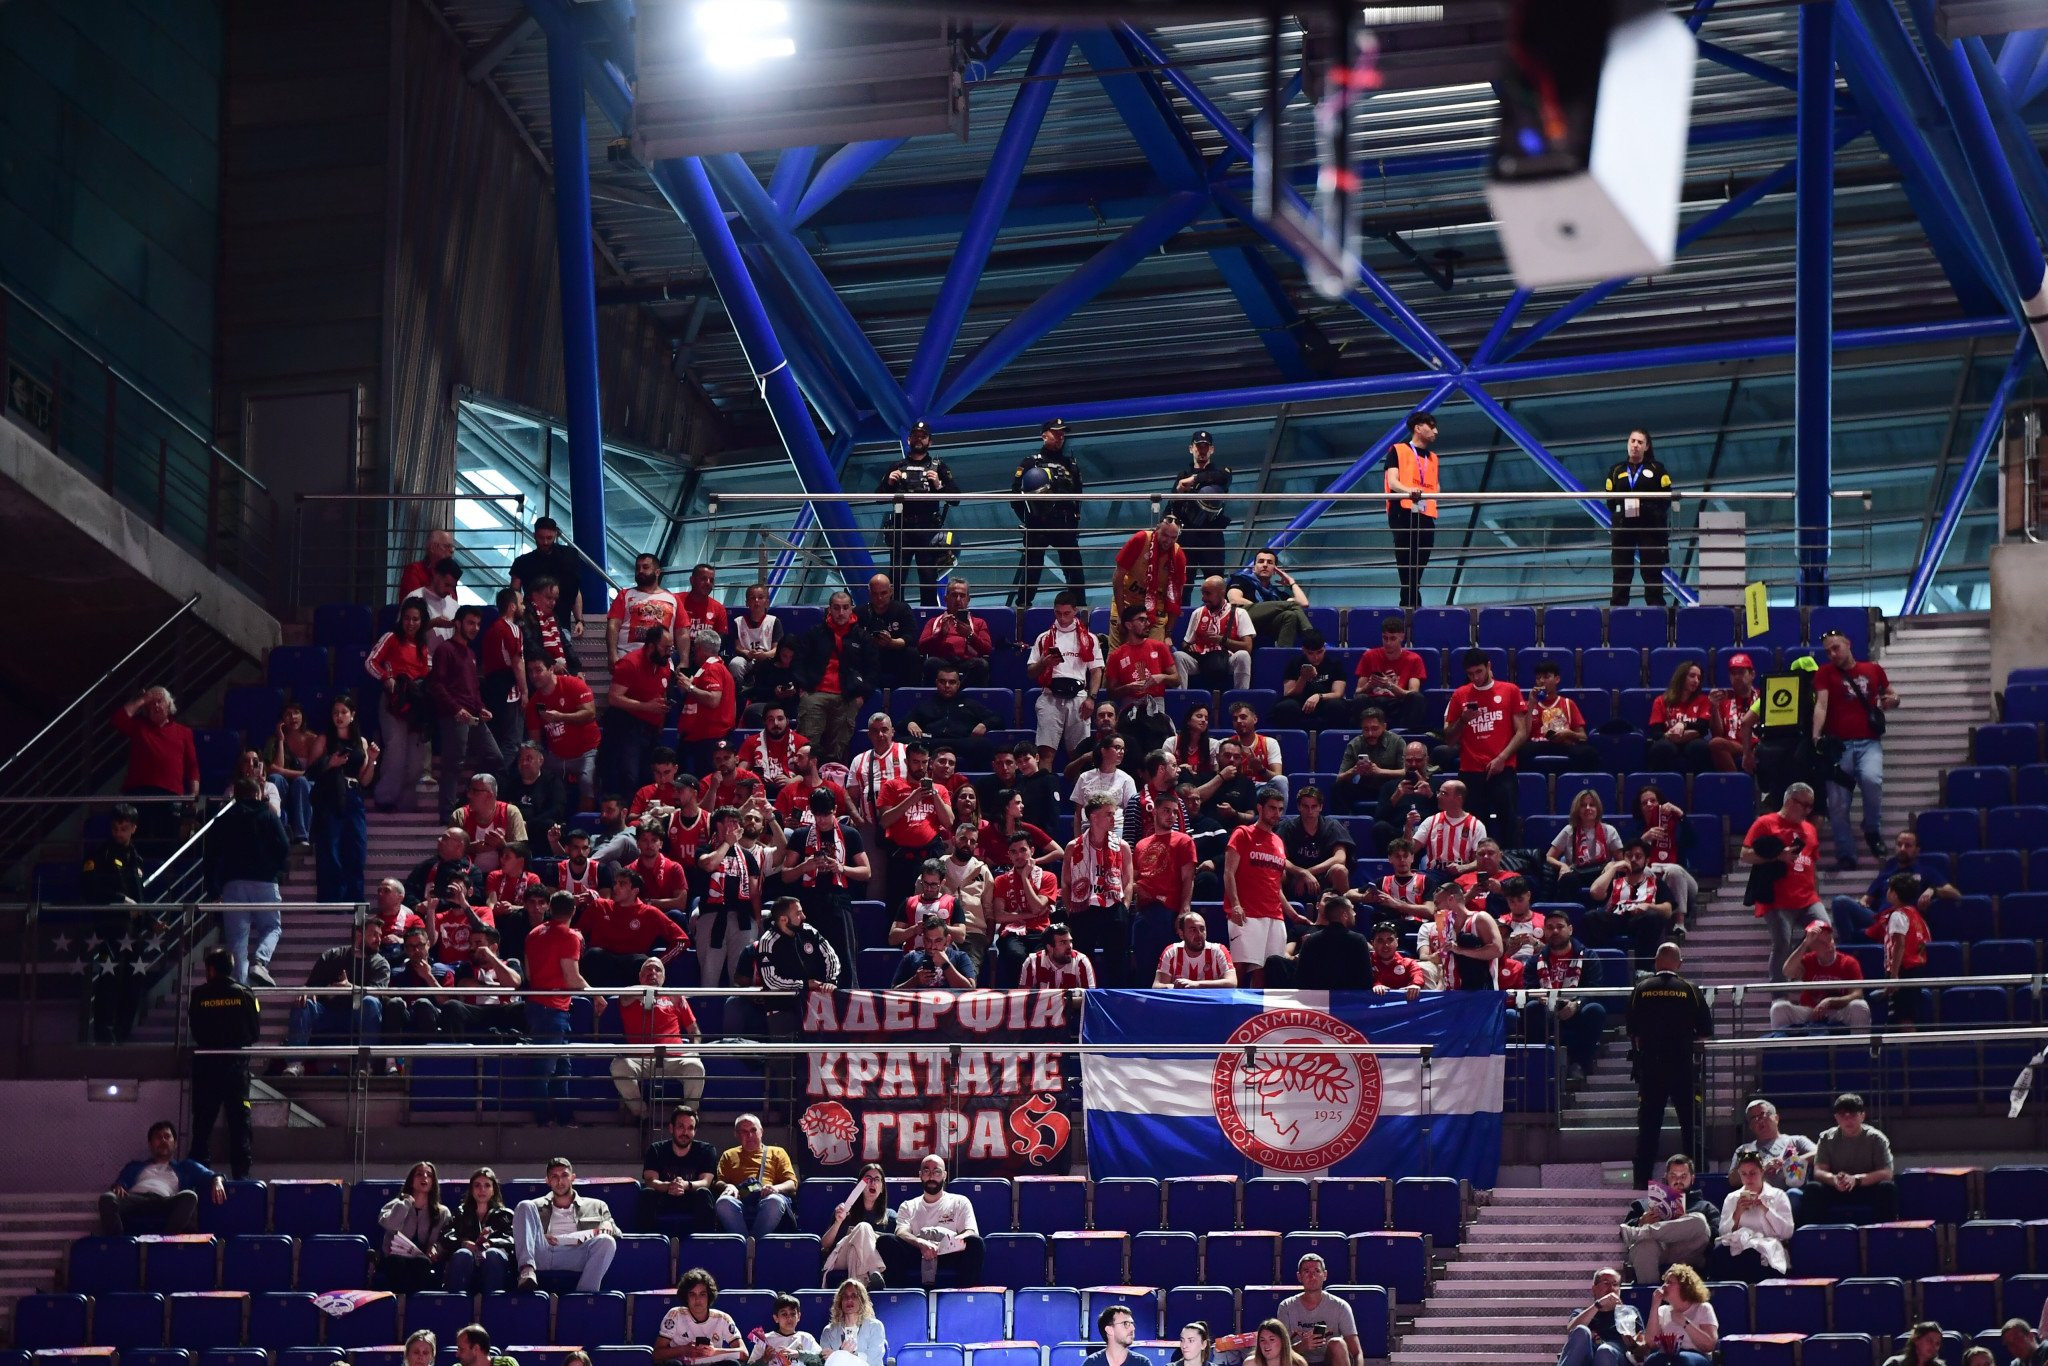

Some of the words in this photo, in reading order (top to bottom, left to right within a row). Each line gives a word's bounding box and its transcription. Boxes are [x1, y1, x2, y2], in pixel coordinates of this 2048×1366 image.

[1471, 721, 1494, 733] TIME
[681, 844, 695, 858] 14
[803, 989, 1067, 1032] ΑΔΕΡΦΙΑ
[1642, 990, 1688, 999] PROSEGUR
[1238, 1012, 1357, 1044] ΟΛΥΜΠΙΑΚΟΣ
[806, 1050, 1063, 1099] ΚΡΑΤΑΤΕ
[1259, 1136, 1357, 1168] ΦΙΛΑΘΛΩΝ
[1355, 1054, 1378, 1129] ΠΕΙΡΑΙΩ
[1314, 1110, 1343, 1122] 1925
[861, 1109, 1009, 1161] ΓΕΡΑ
